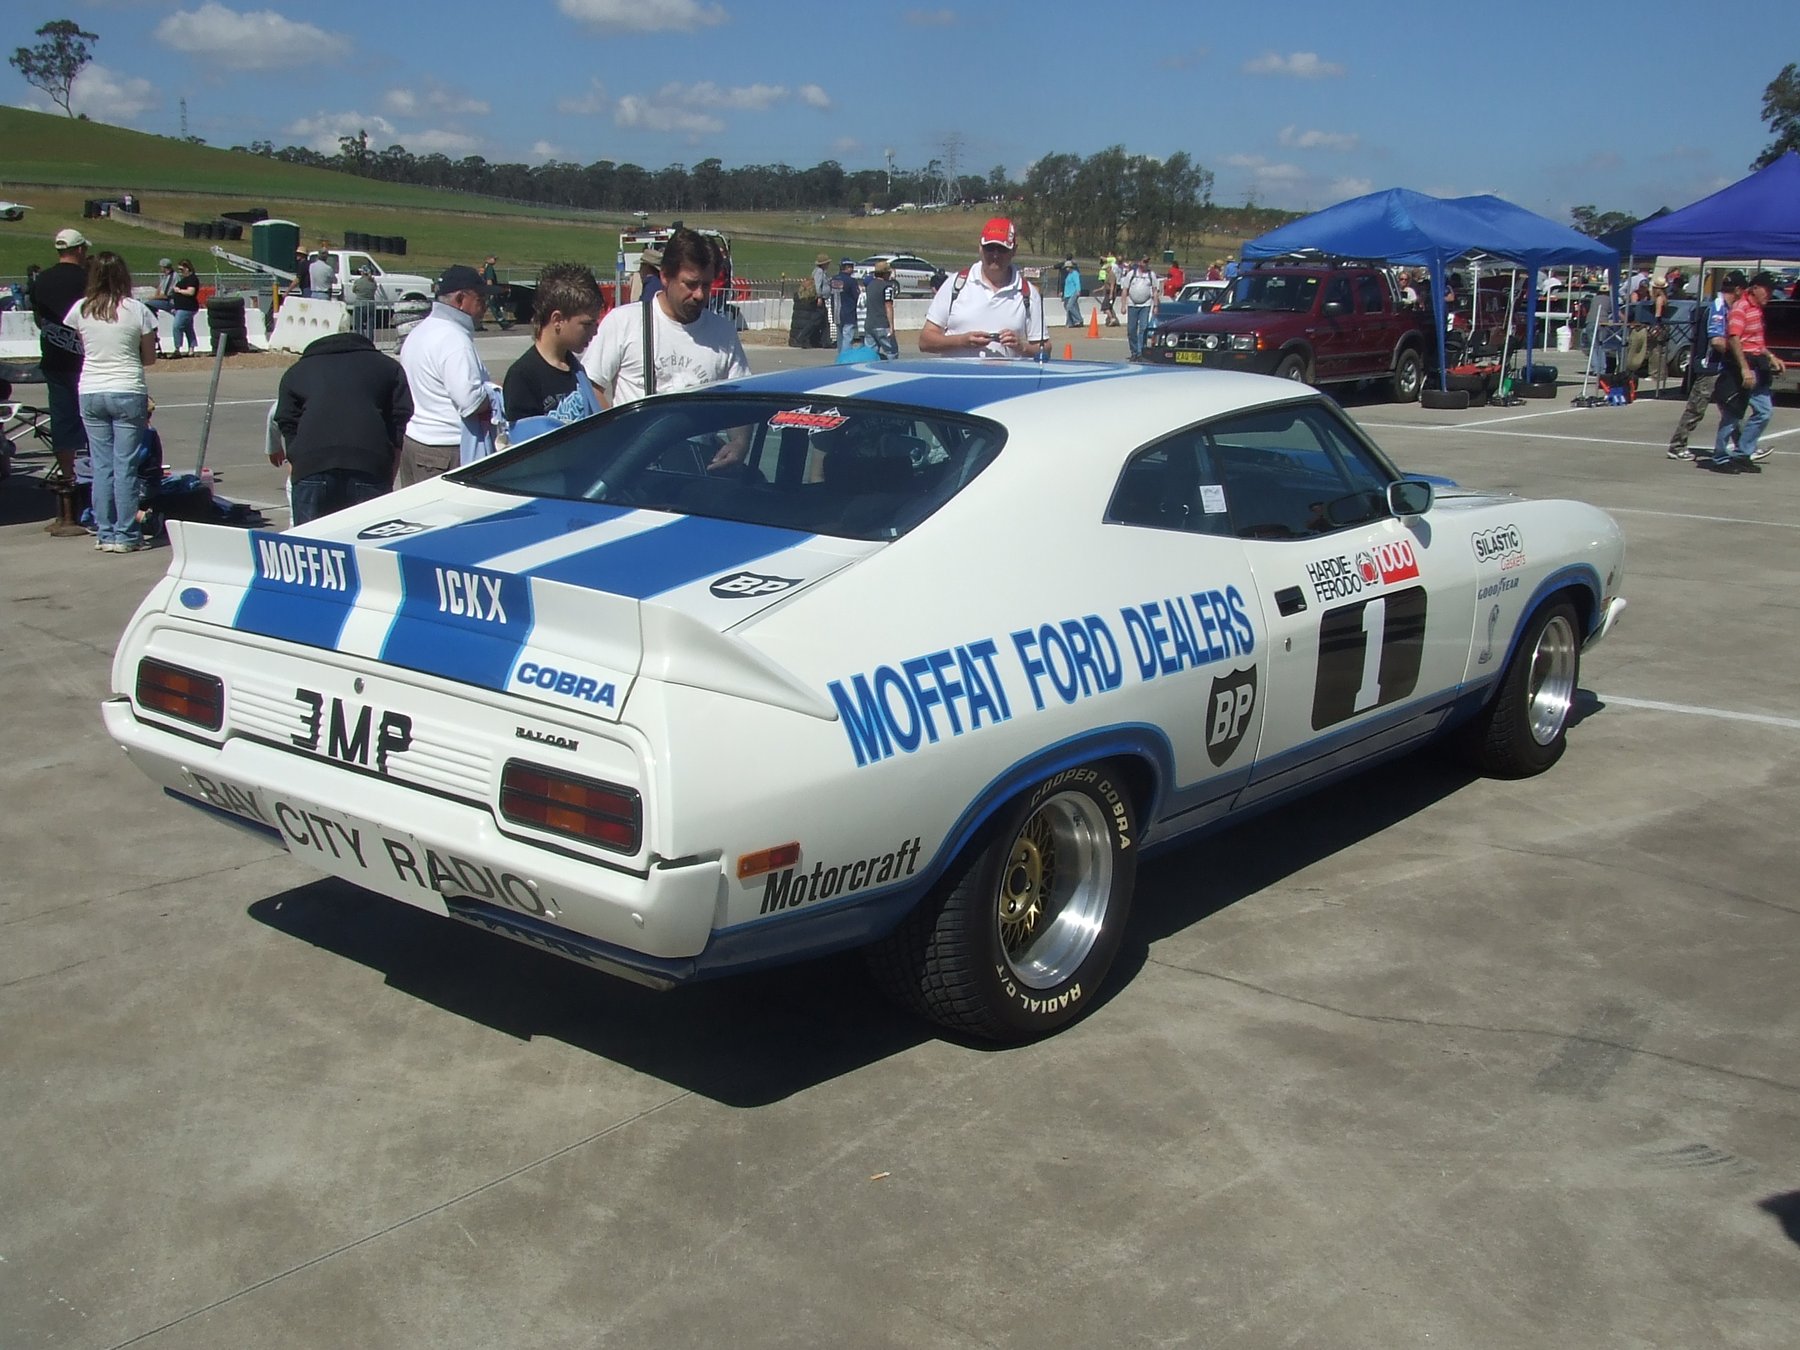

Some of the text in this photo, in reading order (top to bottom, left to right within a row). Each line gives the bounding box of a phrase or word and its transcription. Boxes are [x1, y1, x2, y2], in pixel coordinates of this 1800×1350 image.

[671, 355, 693, 368] BAY
[362, 522, 423, 537] BP
[1476, 531, 1519, 557] SILASTIC
[258, 539, 347, 592] MOFFAT
[1374, 540, 1414, 573] 1000
[435, 568, 507, 624] ICKX
[711, 575, 790, 595] BP
[1313, 574, 1362, 603] FERODO
[826, 584, 1255, 768] MOFFAT FORD DEALERS
[1353, 597, 1386, 713] 1
[517, 661, 616, 709] COBRA
[290, 687, 414, 776] 3MP
[515, 726, 579, 752] FALCON
[1208, 683, 1254, 747] BP
[1031, 768, 1131, 850] COOPER COBRA
[192, 771, 547, 917] BAY CITY RADIO
[760, 836, 922, 915] Motorcraft
[996, 965, 1081, 1013] RADIAL G/T
